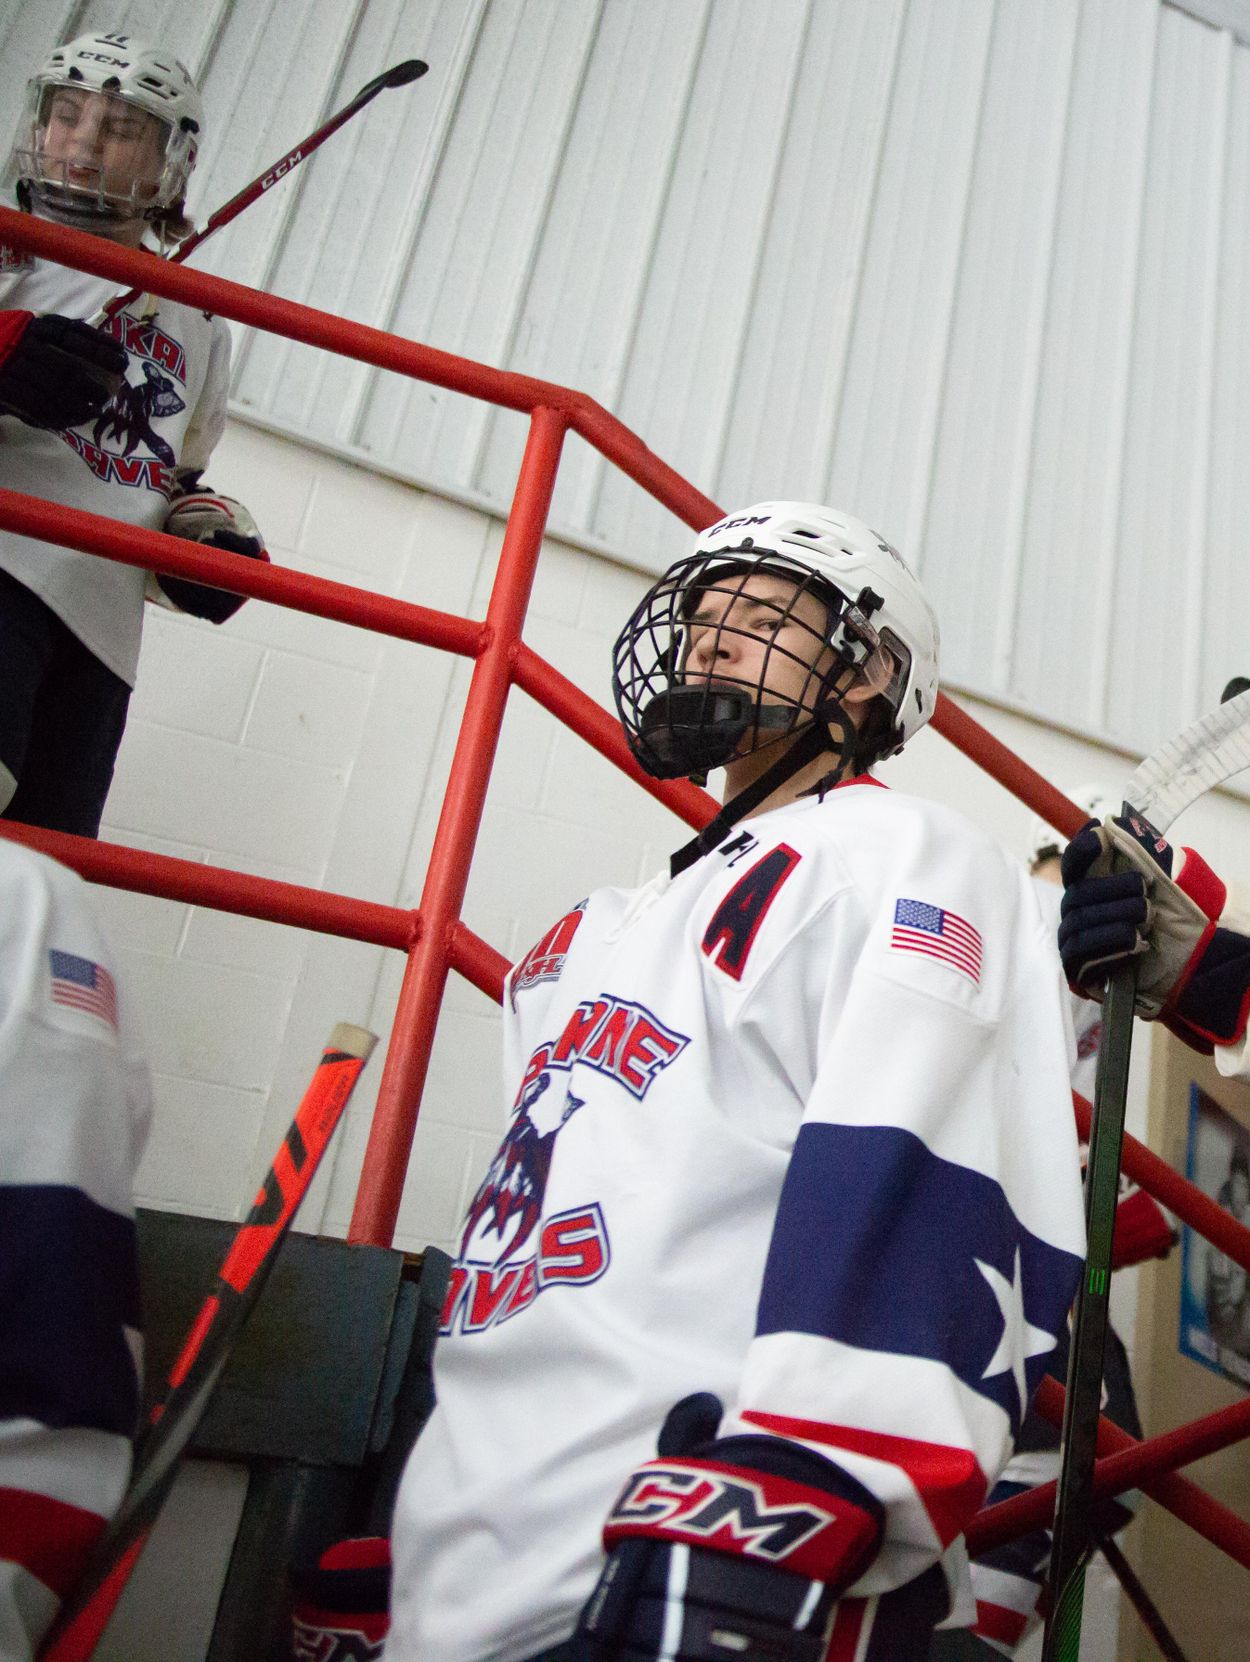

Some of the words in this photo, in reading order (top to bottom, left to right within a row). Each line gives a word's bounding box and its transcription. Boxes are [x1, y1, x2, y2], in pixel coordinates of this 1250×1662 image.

[76, 51, 130, 68] CCM
[261, 151, 303, 190] CCM
[708, 515, 772, 538] CCM
[701, 841, 803, 983] A
